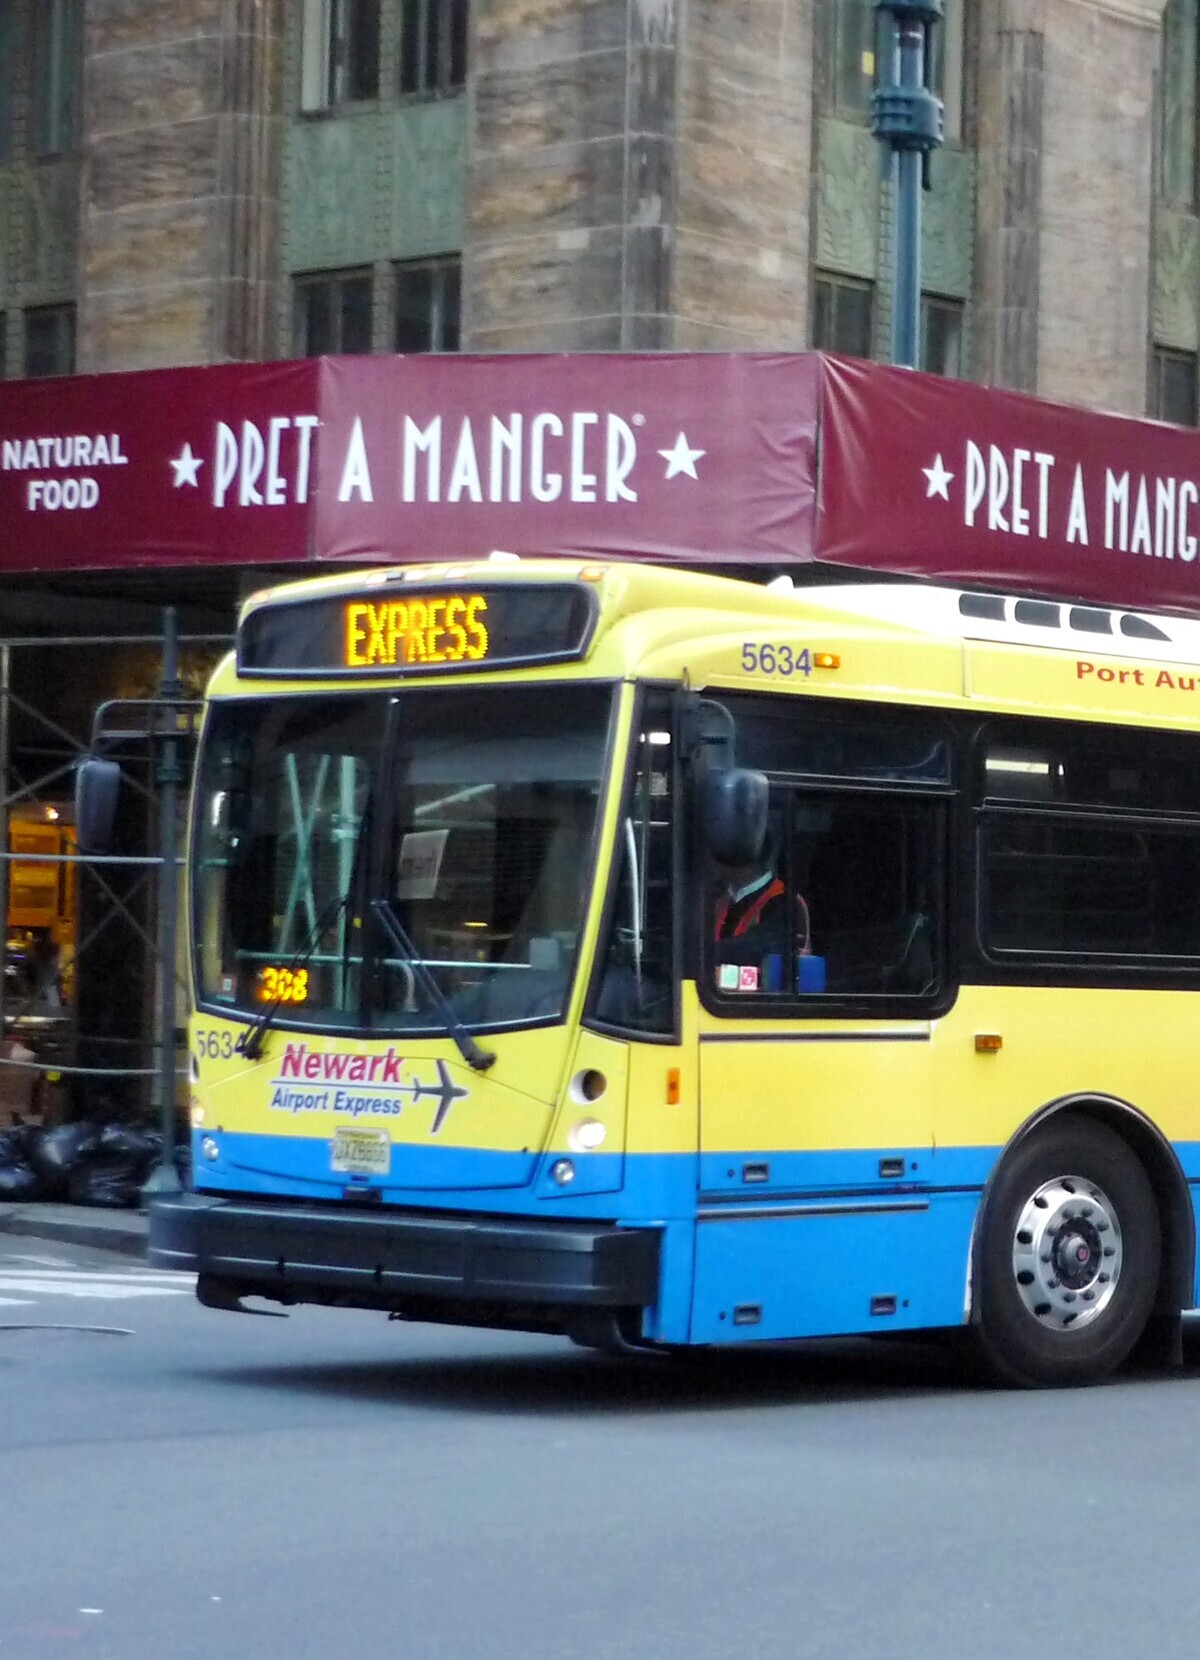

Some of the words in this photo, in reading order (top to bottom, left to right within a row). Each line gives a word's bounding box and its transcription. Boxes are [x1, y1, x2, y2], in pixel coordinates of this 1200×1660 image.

[3, 434, 128, 470] NATURAL
[213, 416, 320, 508] PRET
[338, 416, 375, 502] A
[28, 478, 99, 512] FOOD
[965, 439, 1054, 538] PRET
[1066, 463, 1089, 545] A
[346, 596, 489, 666] EXPRESS
[741, 642, 812, 676] 5634
[1076, 661, 1145, 686] Port
[280, 1044, 405, 1083] Newark
[271, 1087, 328, 1113] Airport
[333, 1091, 401, 1117] Express
